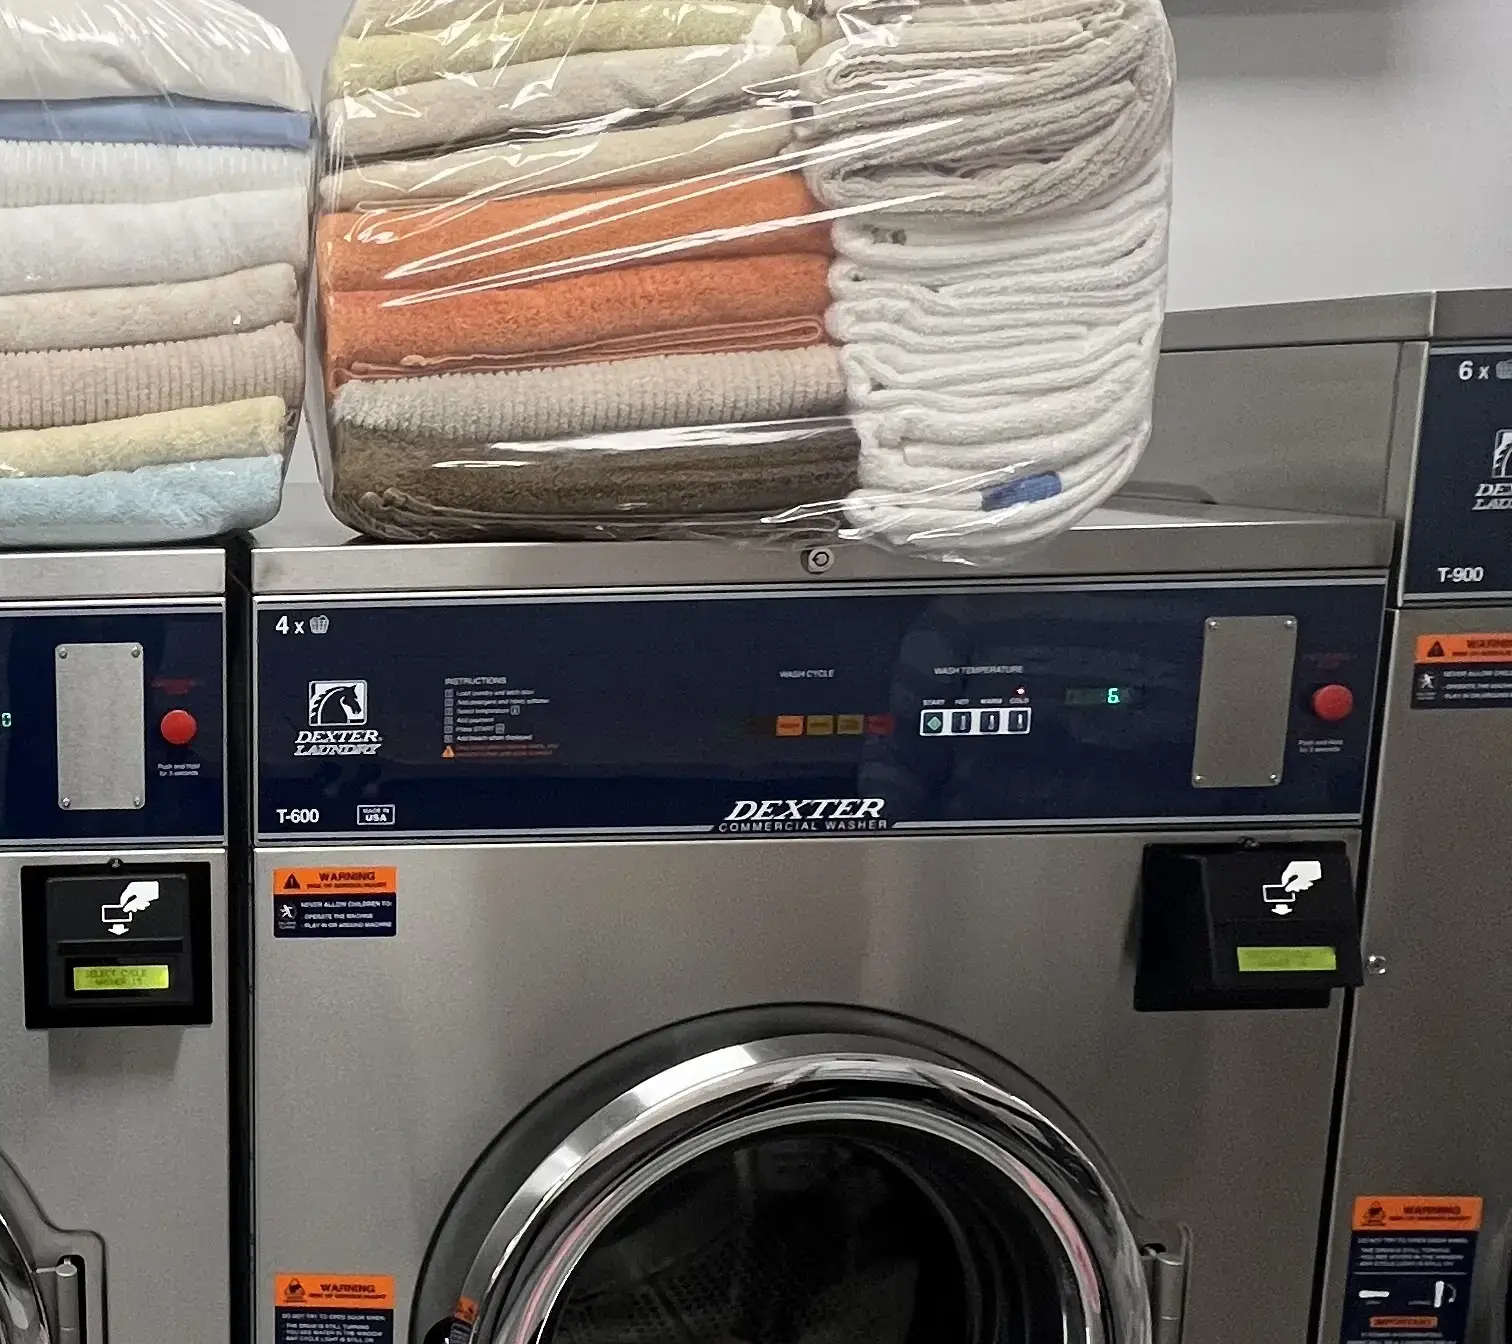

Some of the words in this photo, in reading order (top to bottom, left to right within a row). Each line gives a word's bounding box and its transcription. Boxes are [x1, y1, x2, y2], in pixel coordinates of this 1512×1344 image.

[1458, 360, 1474, 381] 6
[1437, 567, 1484, 582] T-900
[275, 615, 289, 634] 4
[294, 730, 378, 744] DEXTER
[276, 809, 320, 824] T-600
[724, 798, 885, 820] DEXTER
[718, 821, 817, 831] COMMERCIAL
[825, 819, 887, 829] WASHER
[319, 872, 375, 882] WARNING
[320, 1284, 376, 1293] WARNING
